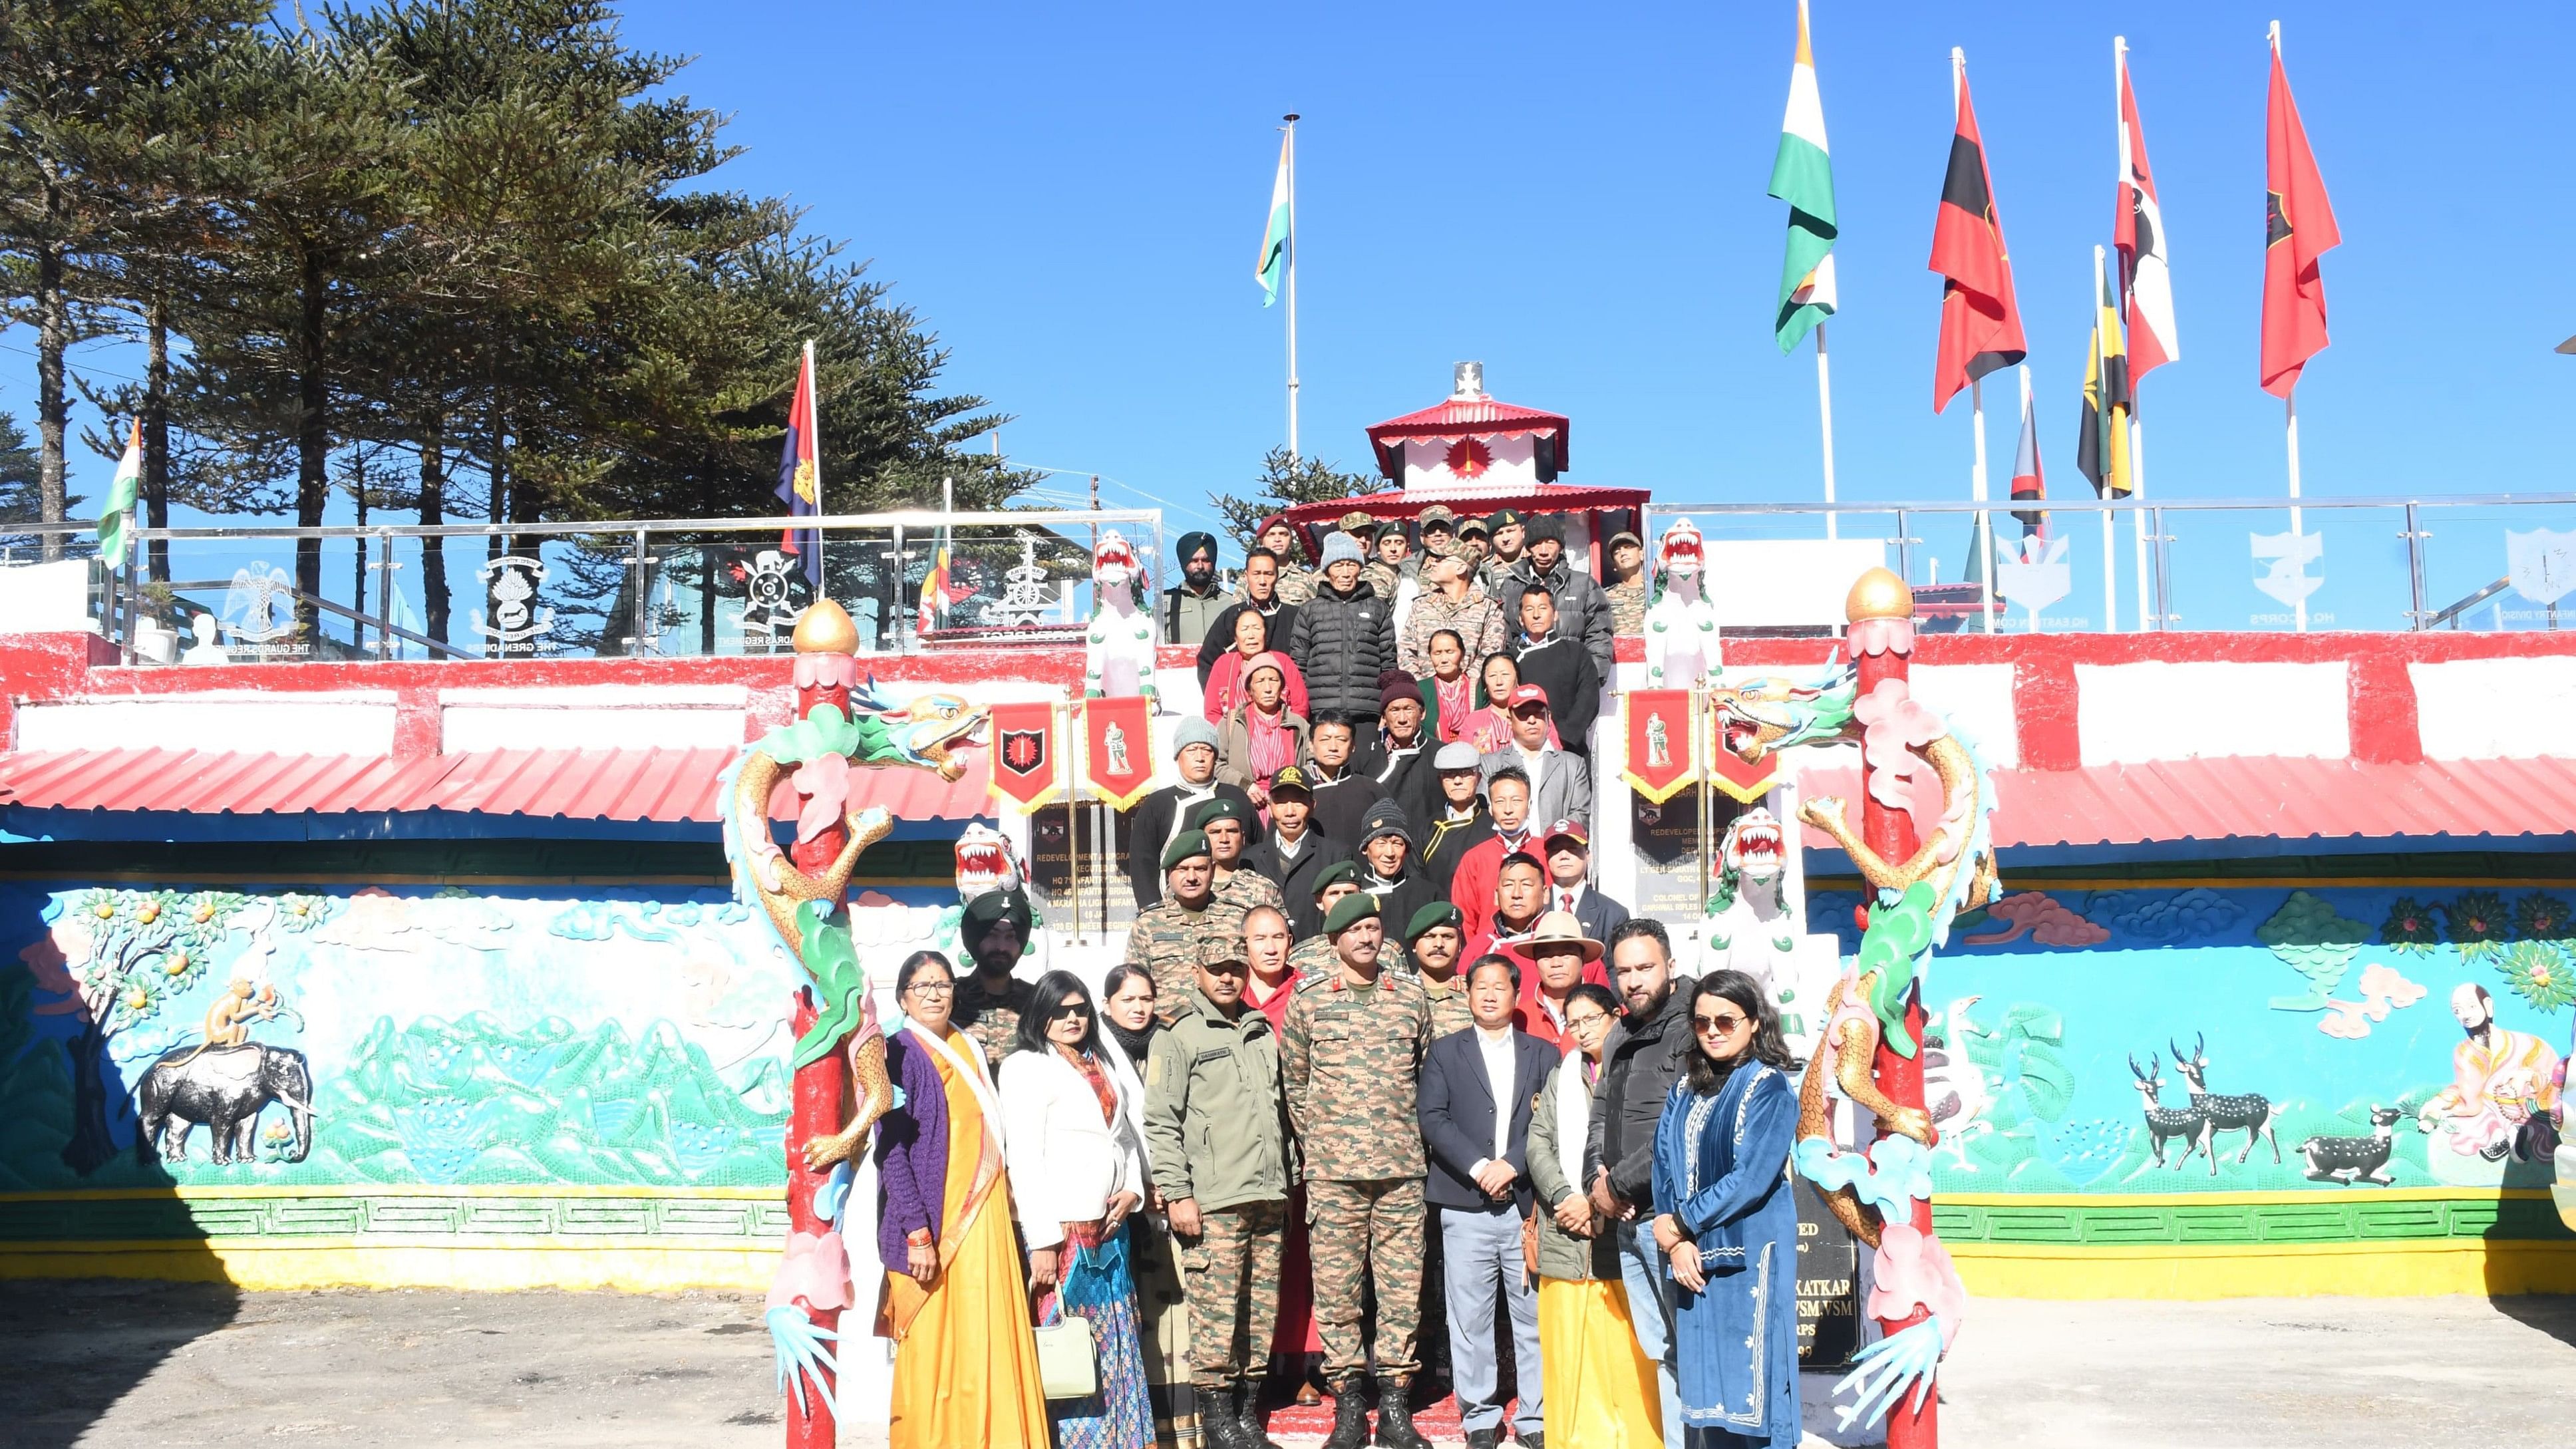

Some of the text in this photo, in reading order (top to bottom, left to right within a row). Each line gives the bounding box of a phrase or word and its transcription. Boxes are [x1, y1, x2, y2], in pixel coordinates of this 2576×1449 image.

[1106, 852, 1130, 860] UPGRA
[1052, 899, 1086, 907] MARAHA
[1110, 898, 1137, 907] INFANT
[1796, 1279, 1851, 1296] KATKAR
[1798, 1346, 1812, 1358] 99
